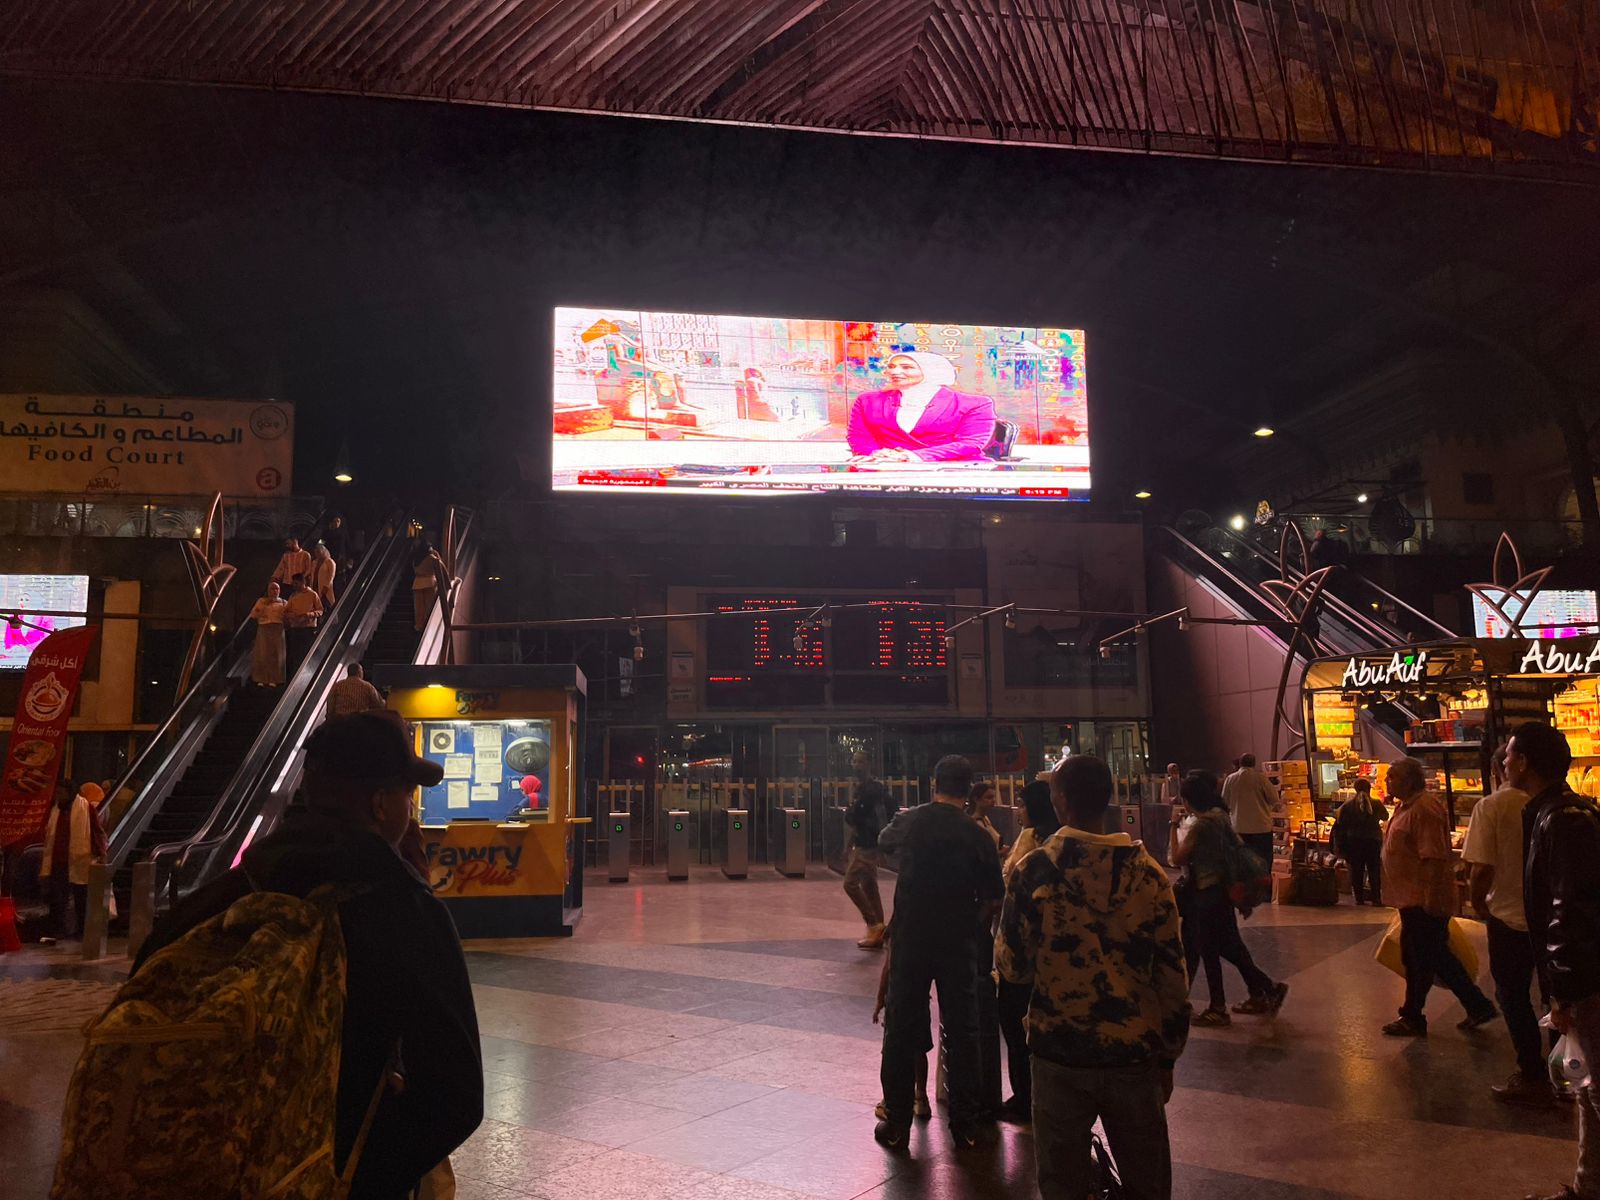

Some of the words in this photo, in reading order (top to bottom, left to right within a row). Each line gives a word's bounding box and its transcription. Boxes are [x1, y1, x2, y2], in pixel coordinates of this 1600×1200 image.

[112, 428, 126, 443] و
[132, 426, 243, 445] المطاعم
[28, 444, 93, 462] Food
[106, 447, 185, 464] Court
